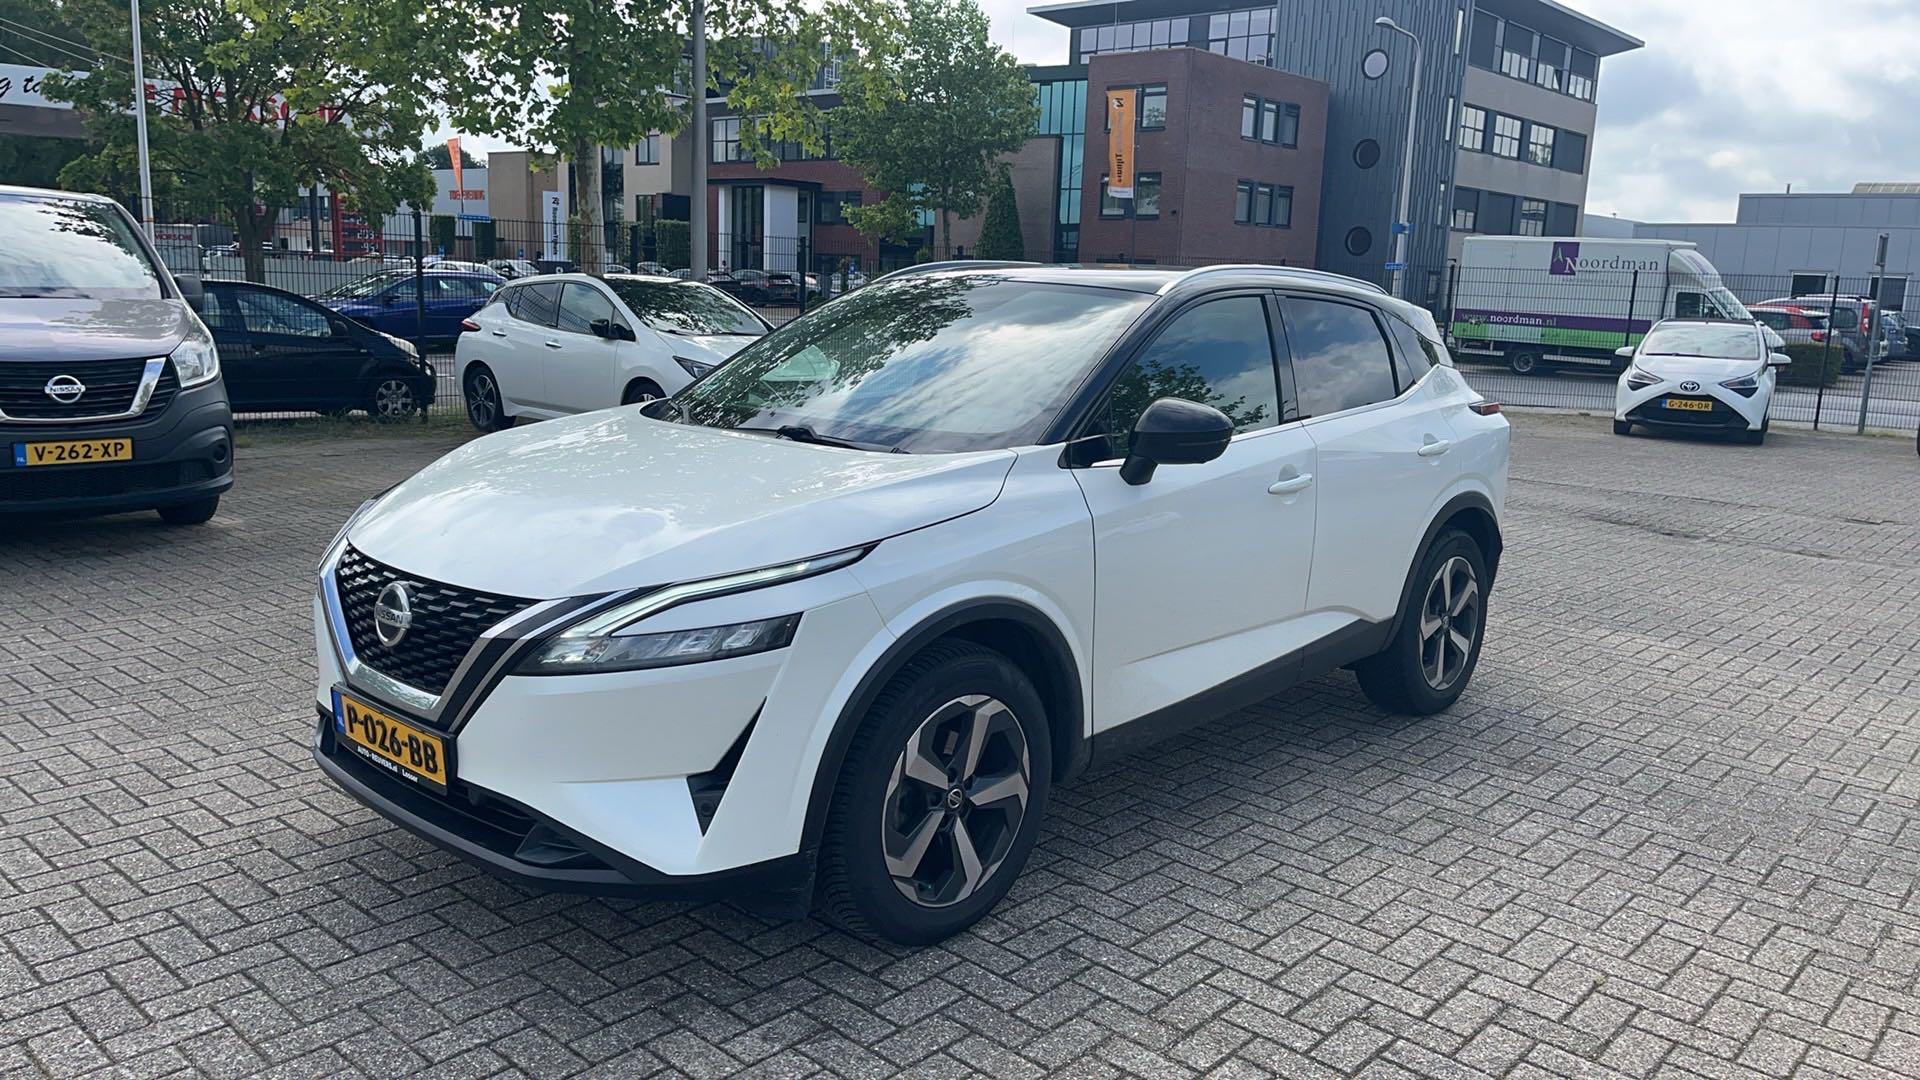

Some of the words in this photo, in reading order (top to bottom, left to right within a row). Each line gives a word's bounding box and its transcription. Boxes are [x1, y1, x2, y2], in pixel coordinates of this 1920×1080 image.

[1563, 255, 1659, 273] Noordman
[1668, 400, 1710, 410] G-246-DR
[34, 442, 125, 462] V-262-XP
[346, 703, 438, 774] P-026-BB
